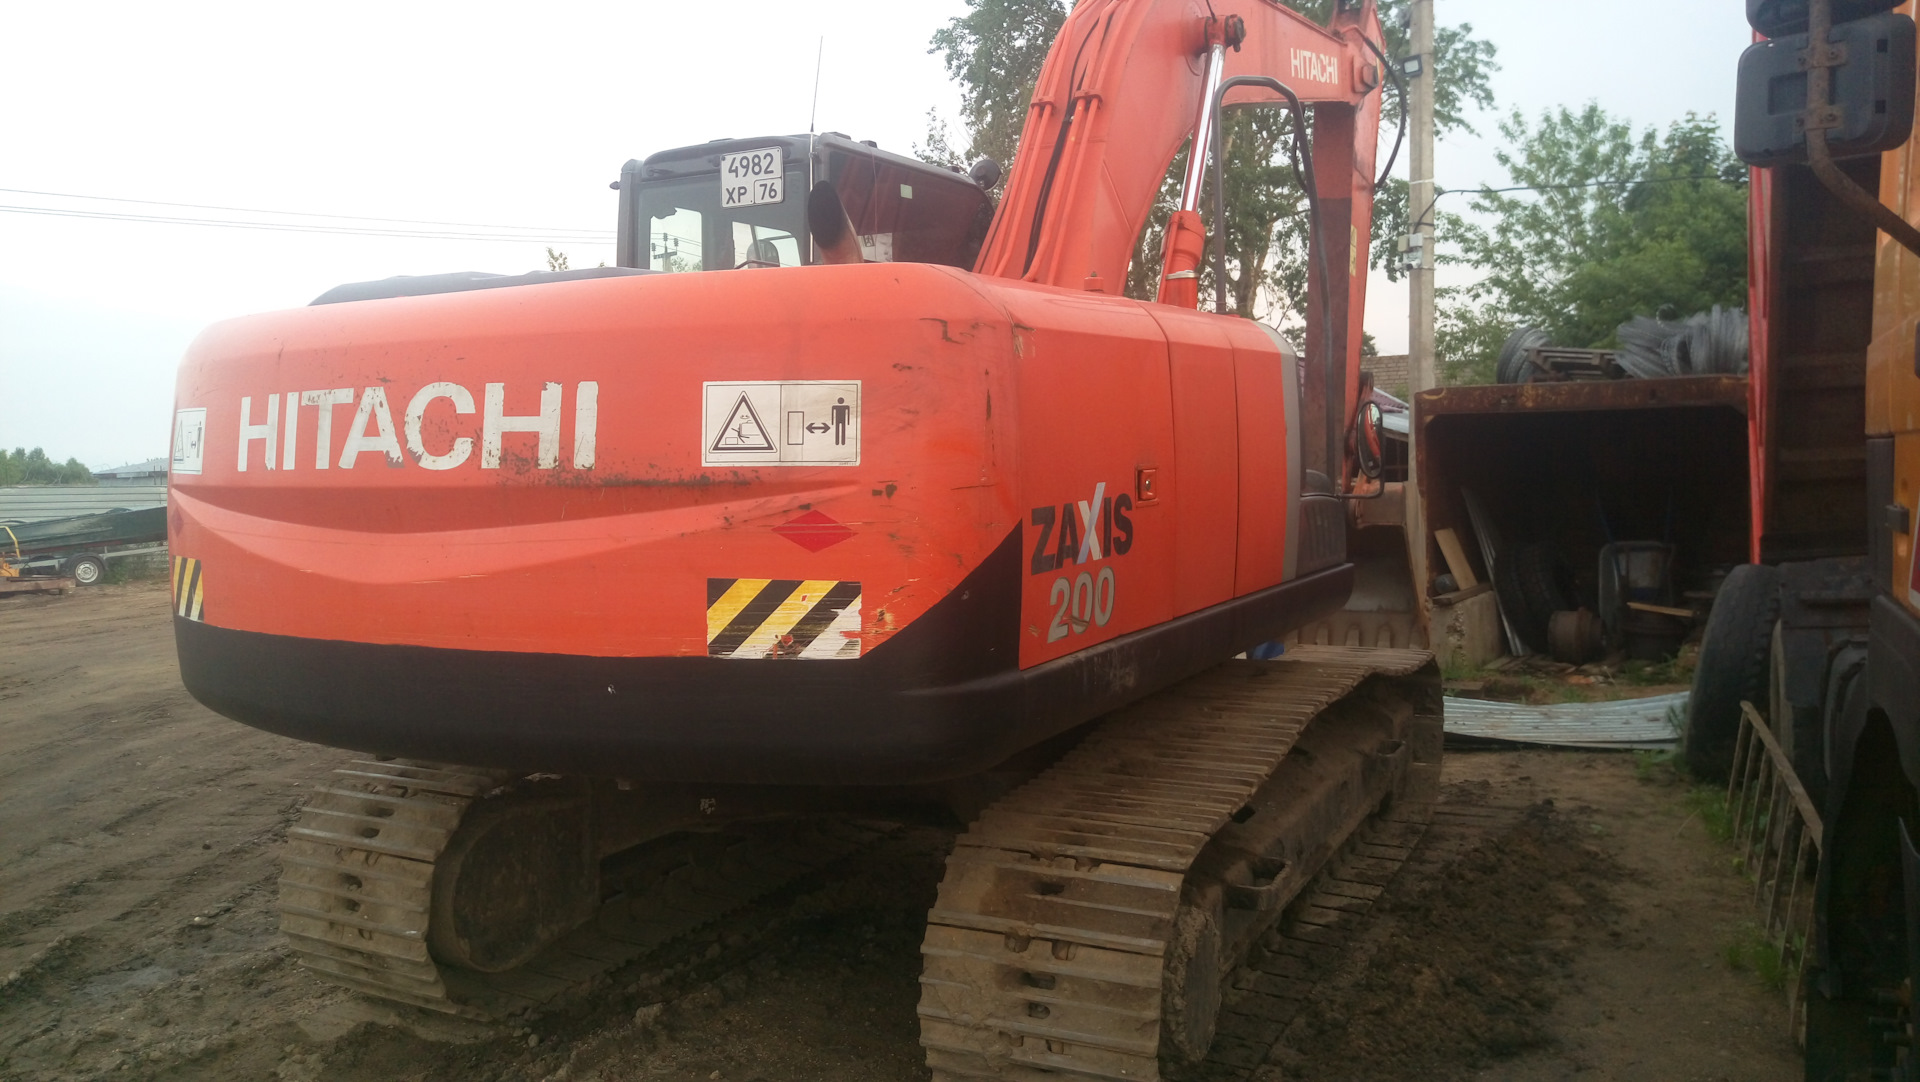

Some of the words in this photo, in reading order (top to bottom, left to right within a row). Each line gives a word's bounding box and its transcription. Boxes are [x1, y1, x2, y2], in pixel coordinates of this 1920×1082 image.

[1290, 47, 1339, 84] HITACHI
[728, 152, 774, 178] 4982
[759, 182, 778, 201] 76
[237, 380, 598, 472] HITACHI
[1031, 482, 1134, 576] ZAXIS
[1047, 565, 1116, 644] 200
